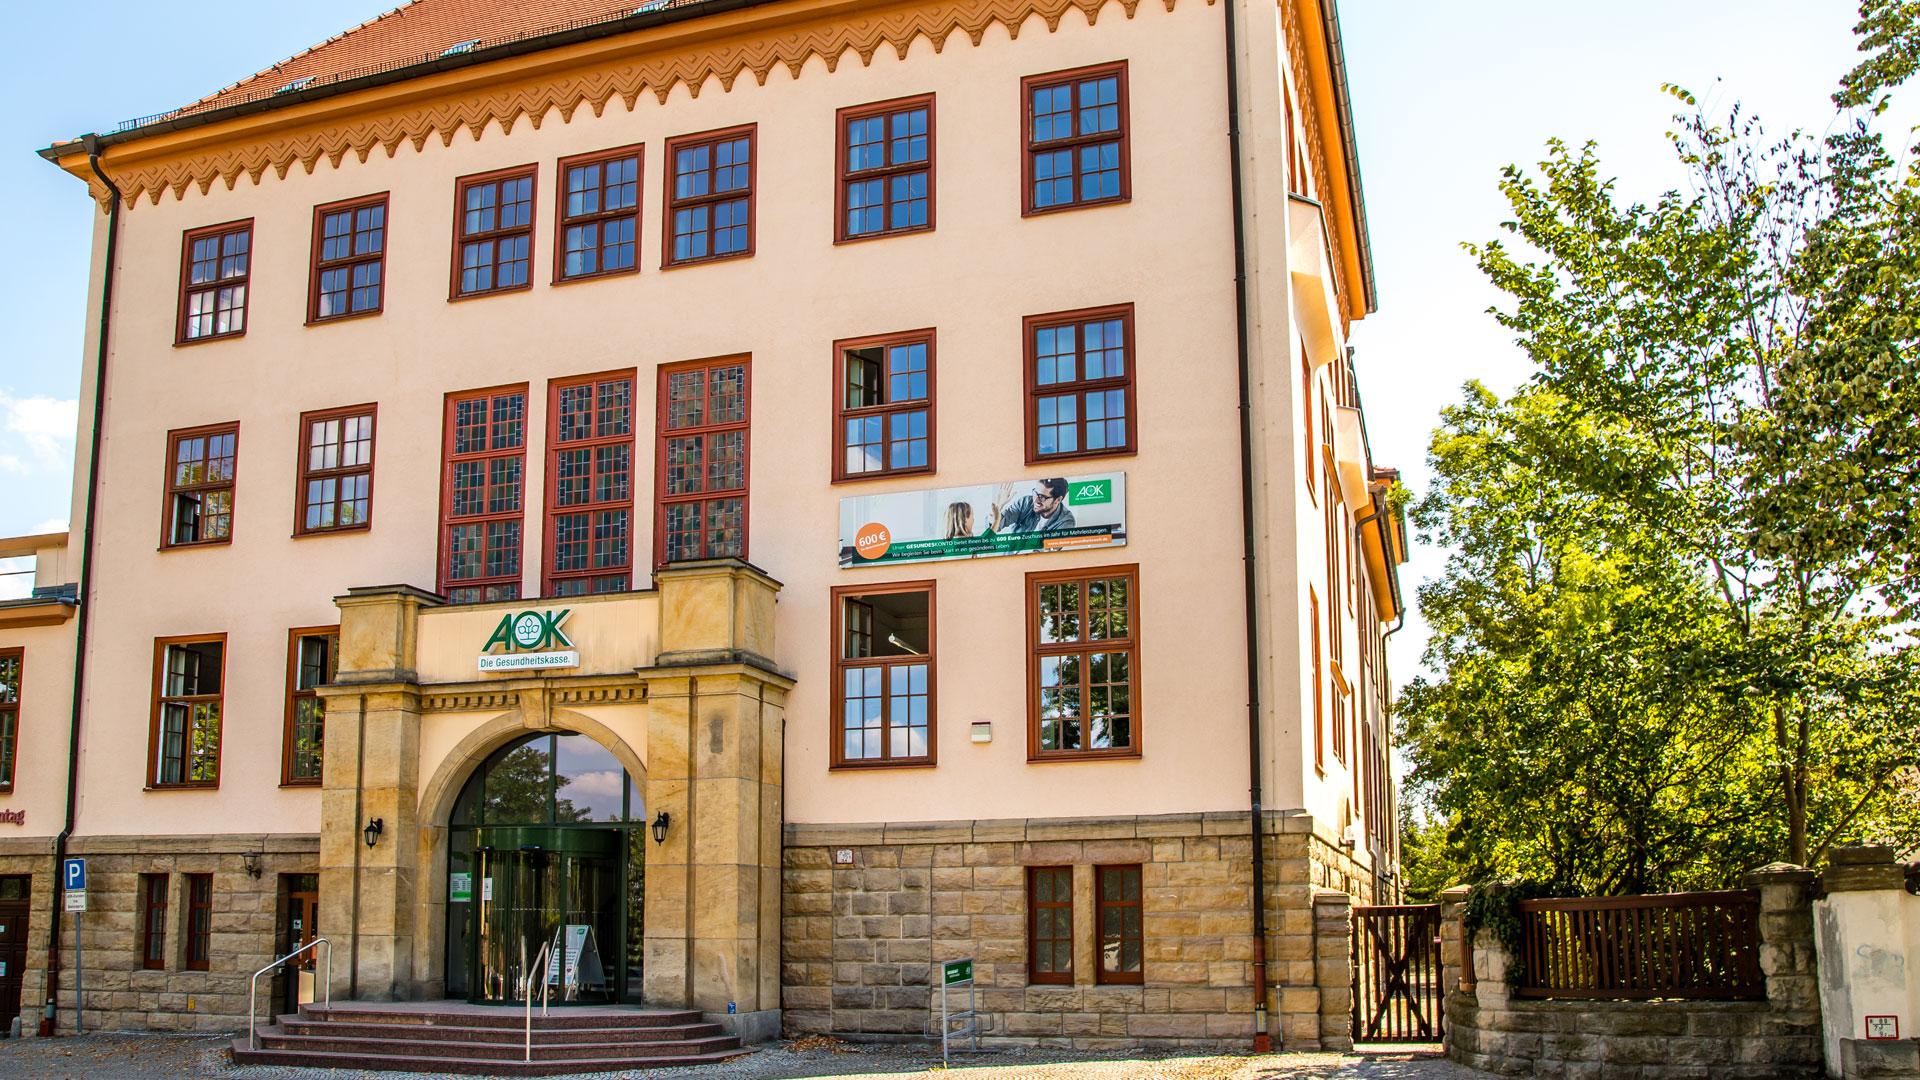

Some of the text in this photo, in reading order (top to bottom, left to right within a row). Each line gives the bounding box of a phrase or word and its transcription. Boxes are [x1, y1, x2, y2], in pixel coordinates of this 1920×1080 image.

[1076, 484, 1104, 498] AOK
[859, 535, 879, 547] 600
[878, 530, 887, 541] €
[906, 540, 954, 550] GESUNDESKONTO
[1021, 532, 1043, 541] Zuschuss
[482, 609, 571, 652] AOK
[480, 655, 571, 668] Die Gesundheitskasse.
[69, 863, 80, 886] P
